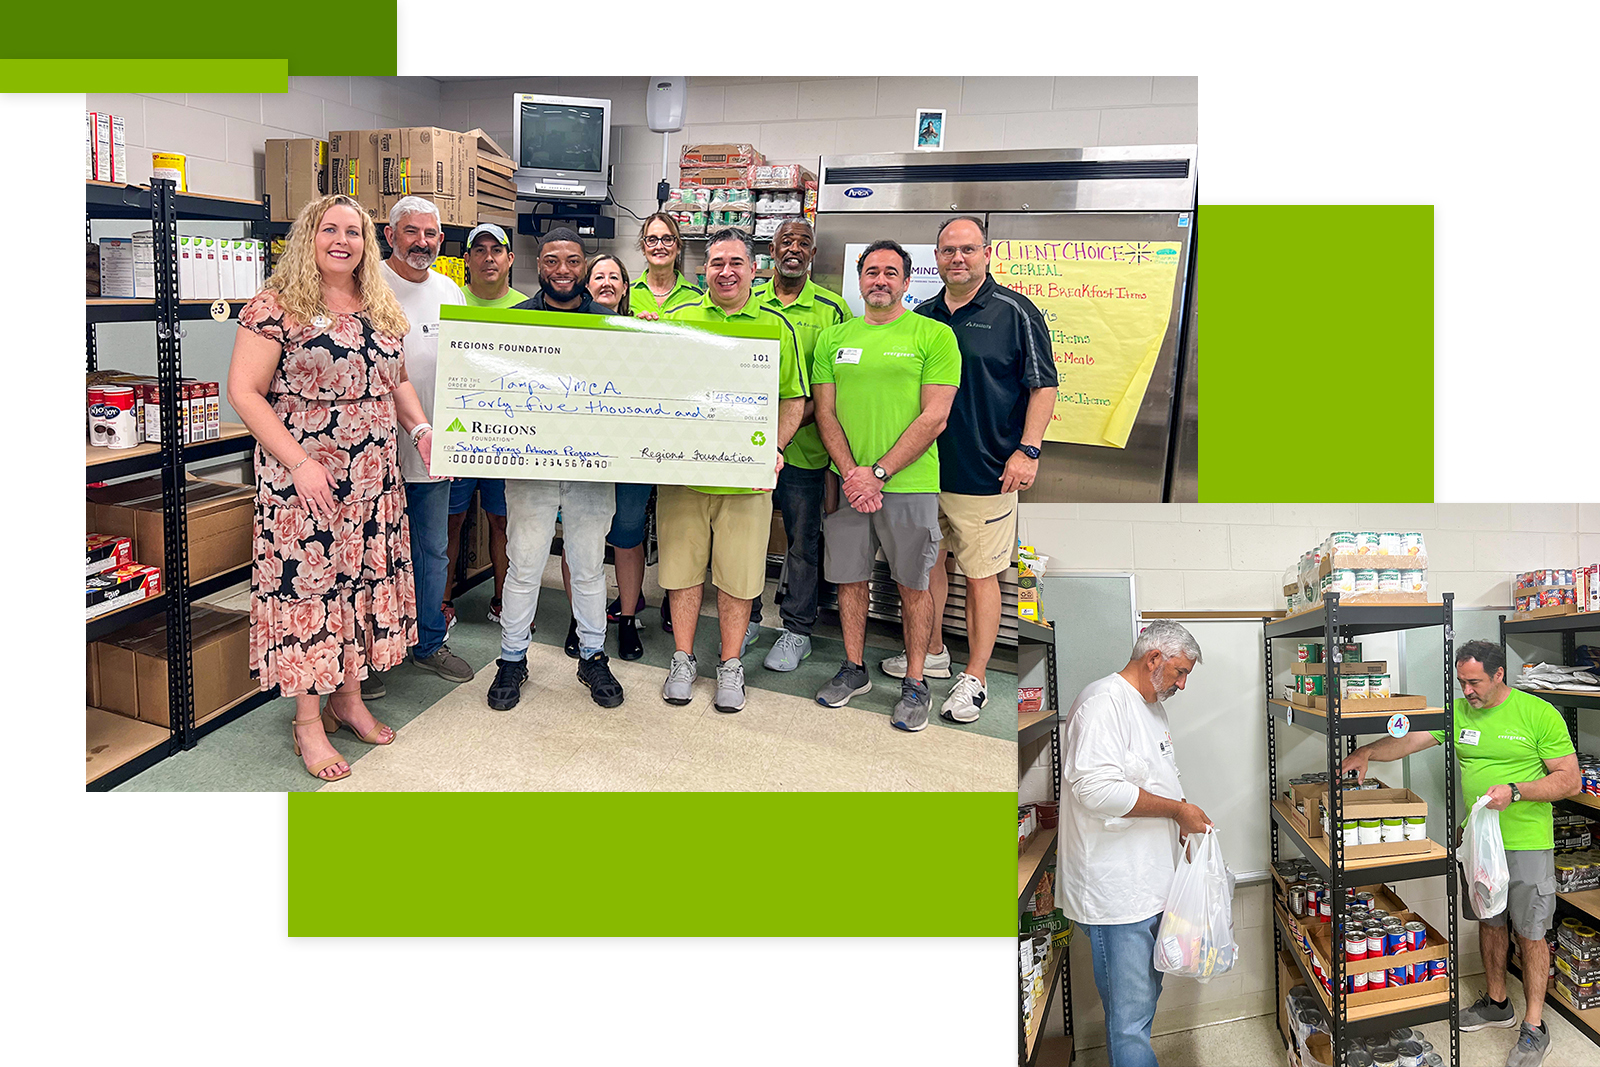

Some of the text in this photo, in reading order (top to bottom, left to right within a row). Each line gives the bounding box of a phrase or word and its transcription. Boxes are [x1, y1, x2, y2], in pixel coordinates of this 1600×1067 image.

[995, 263, 1062, 277] 1 CEREAL
[450, 341, 561, 355] REGIONS FOUNDATION
[753, 354, 769, 362] 101
[490, 371, 621, 398] Tampa YMCA
[585, 400, 671, 415] thousand
[674, 406, 707, 419] and
[472, 421, 536, 435] REGIONS
[563, 446, 609, 461] Program
[639, 447, 755, 463] Regions Foundation
[1394, 718, 1403, 729] 4
